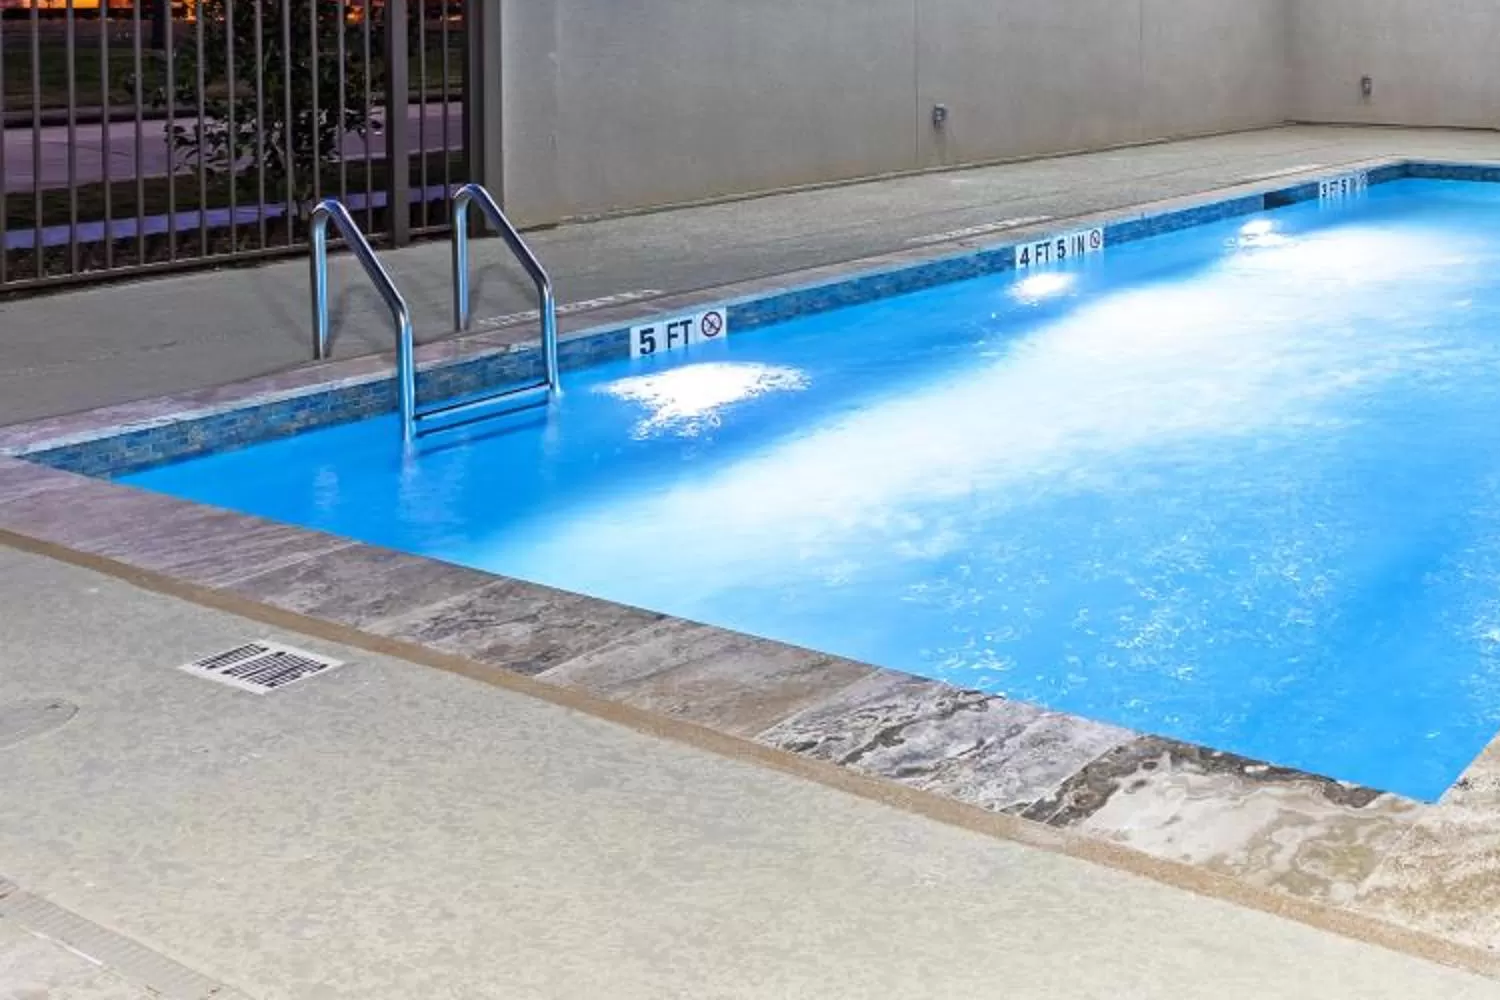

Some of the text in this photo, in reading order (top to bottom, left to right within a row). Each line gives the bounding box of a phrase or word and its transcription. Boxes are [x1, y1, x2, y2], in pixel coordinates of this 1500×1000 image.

[1019, 234, 1085, 267] 4 FT 5 IN
[639, 319, 693, 355] 5 FT
